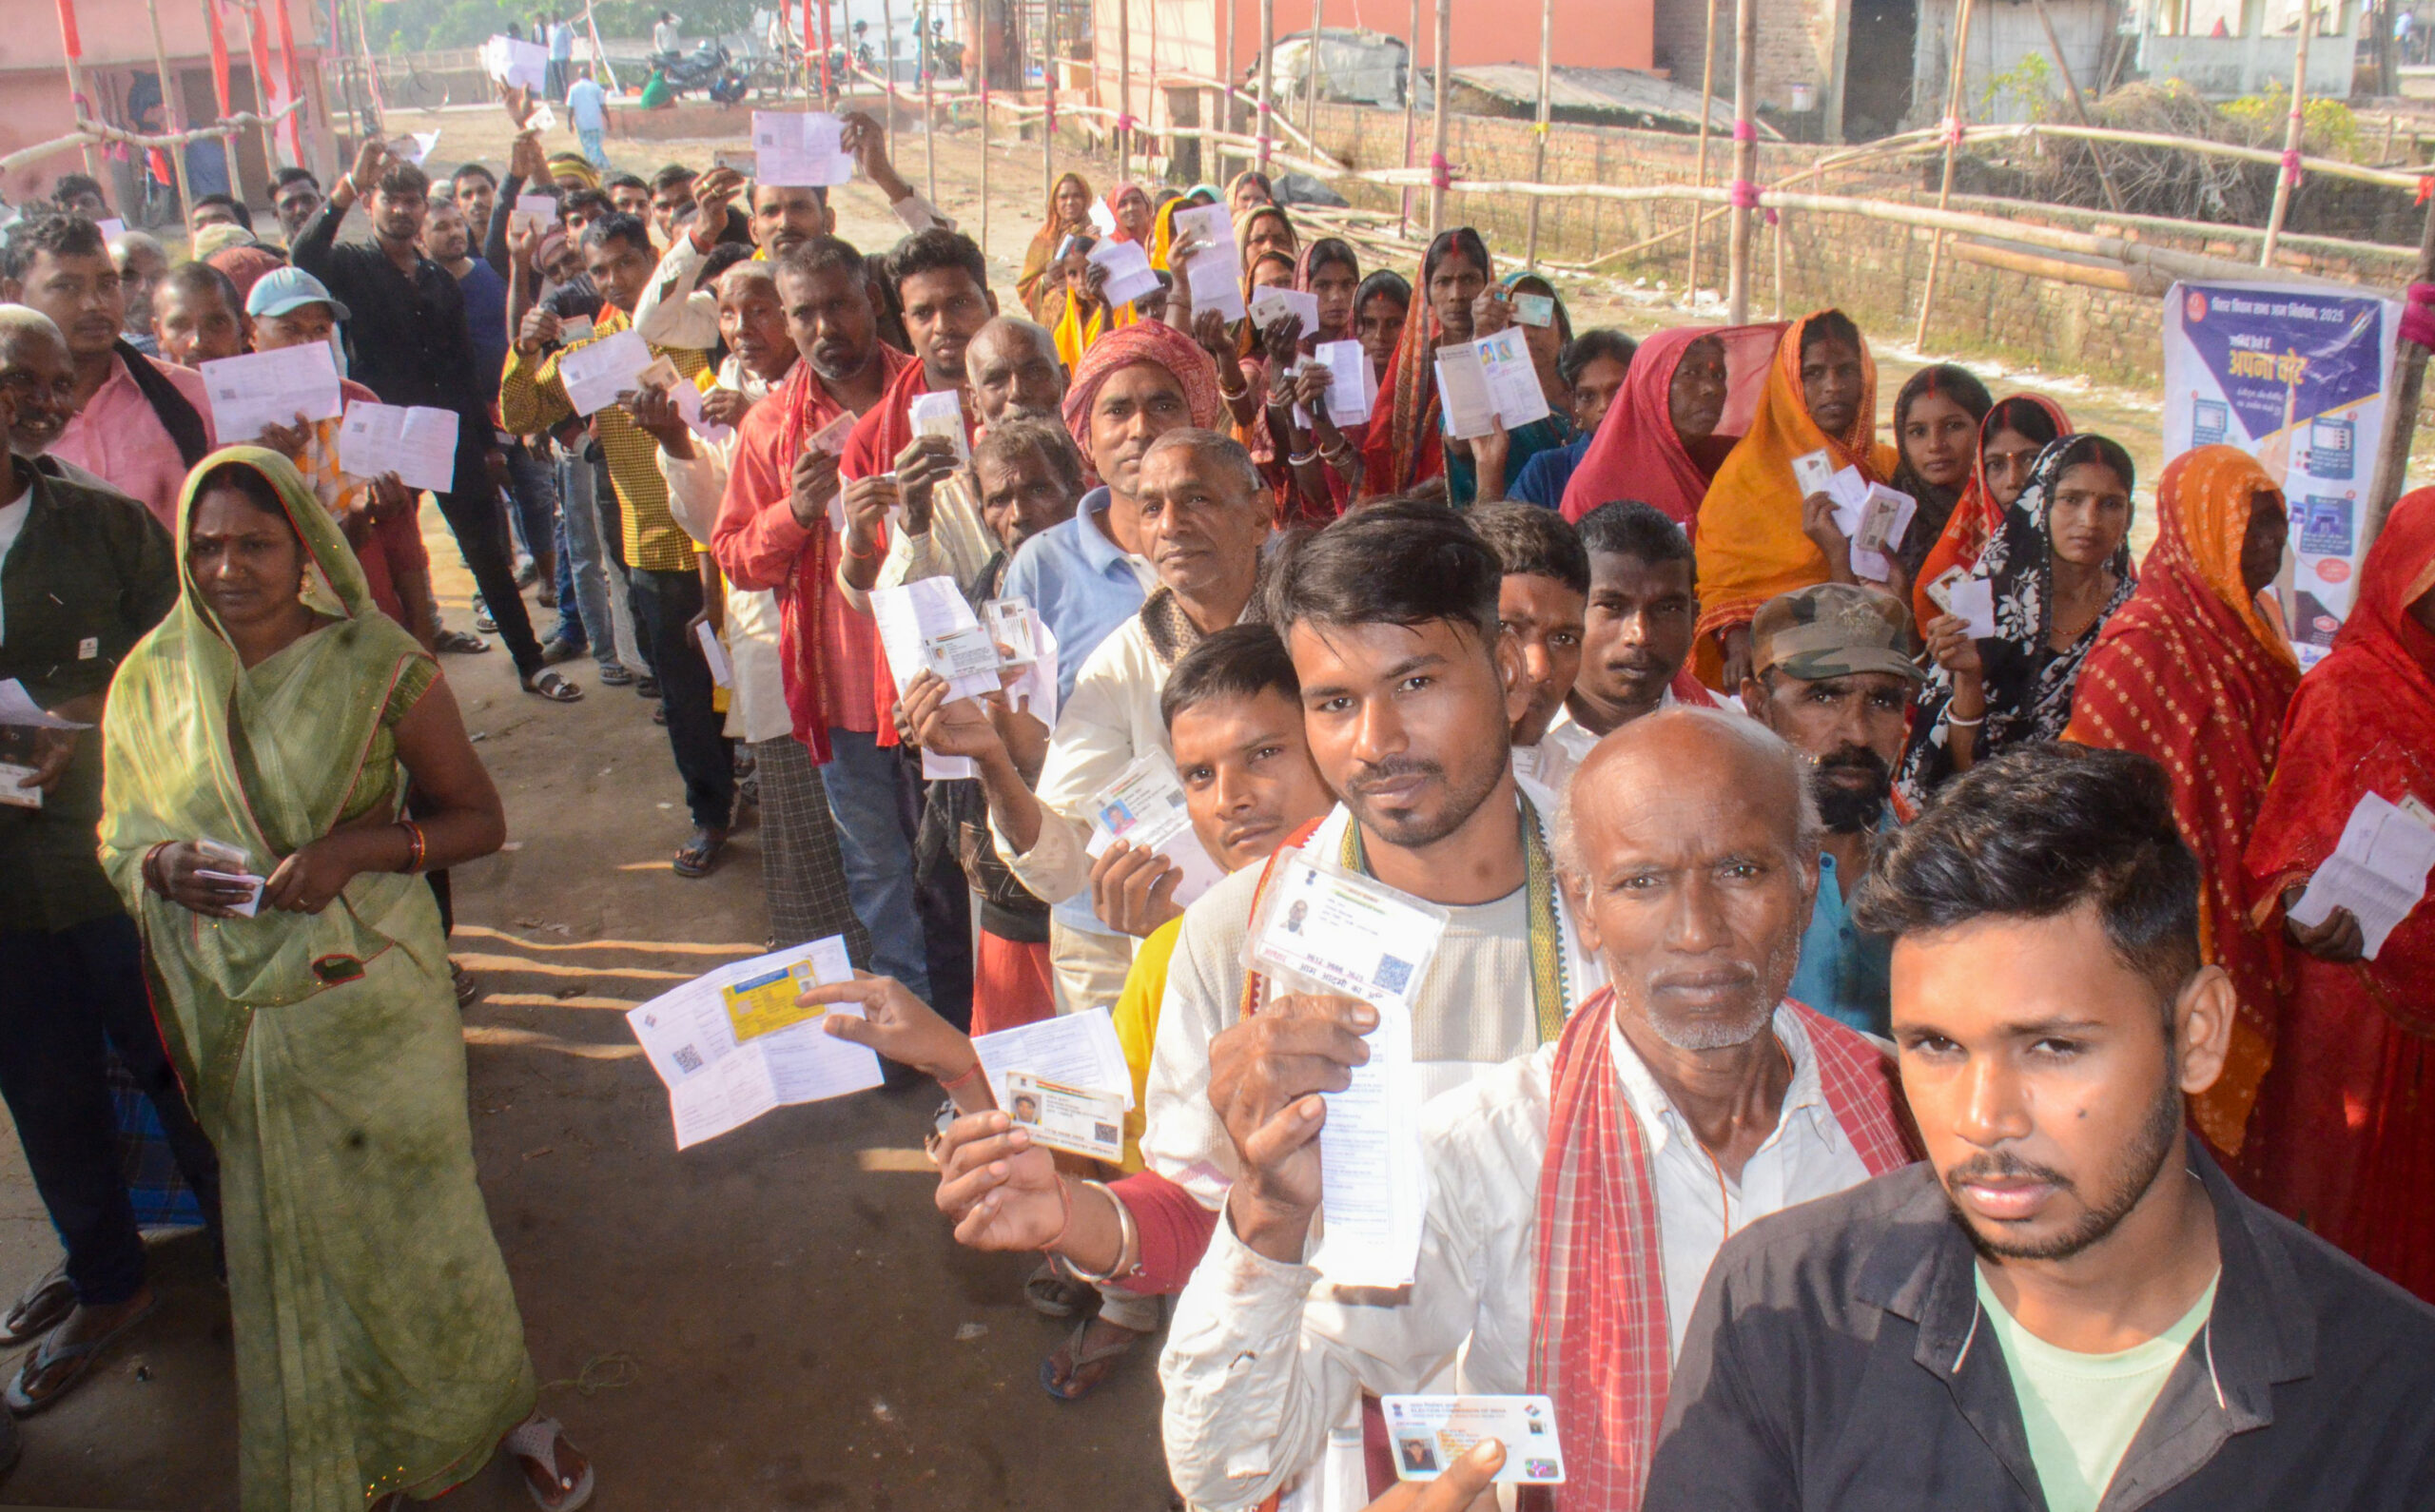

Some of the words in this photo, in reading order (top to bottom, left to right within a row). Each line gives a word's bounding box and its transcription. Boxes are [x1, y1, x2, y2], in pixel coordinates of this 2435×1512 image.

[2319, 307, 2345, 322] 2025
[2229, 349, 2276, 380] अपना
[2277, 347, 2308, 385] वोट
